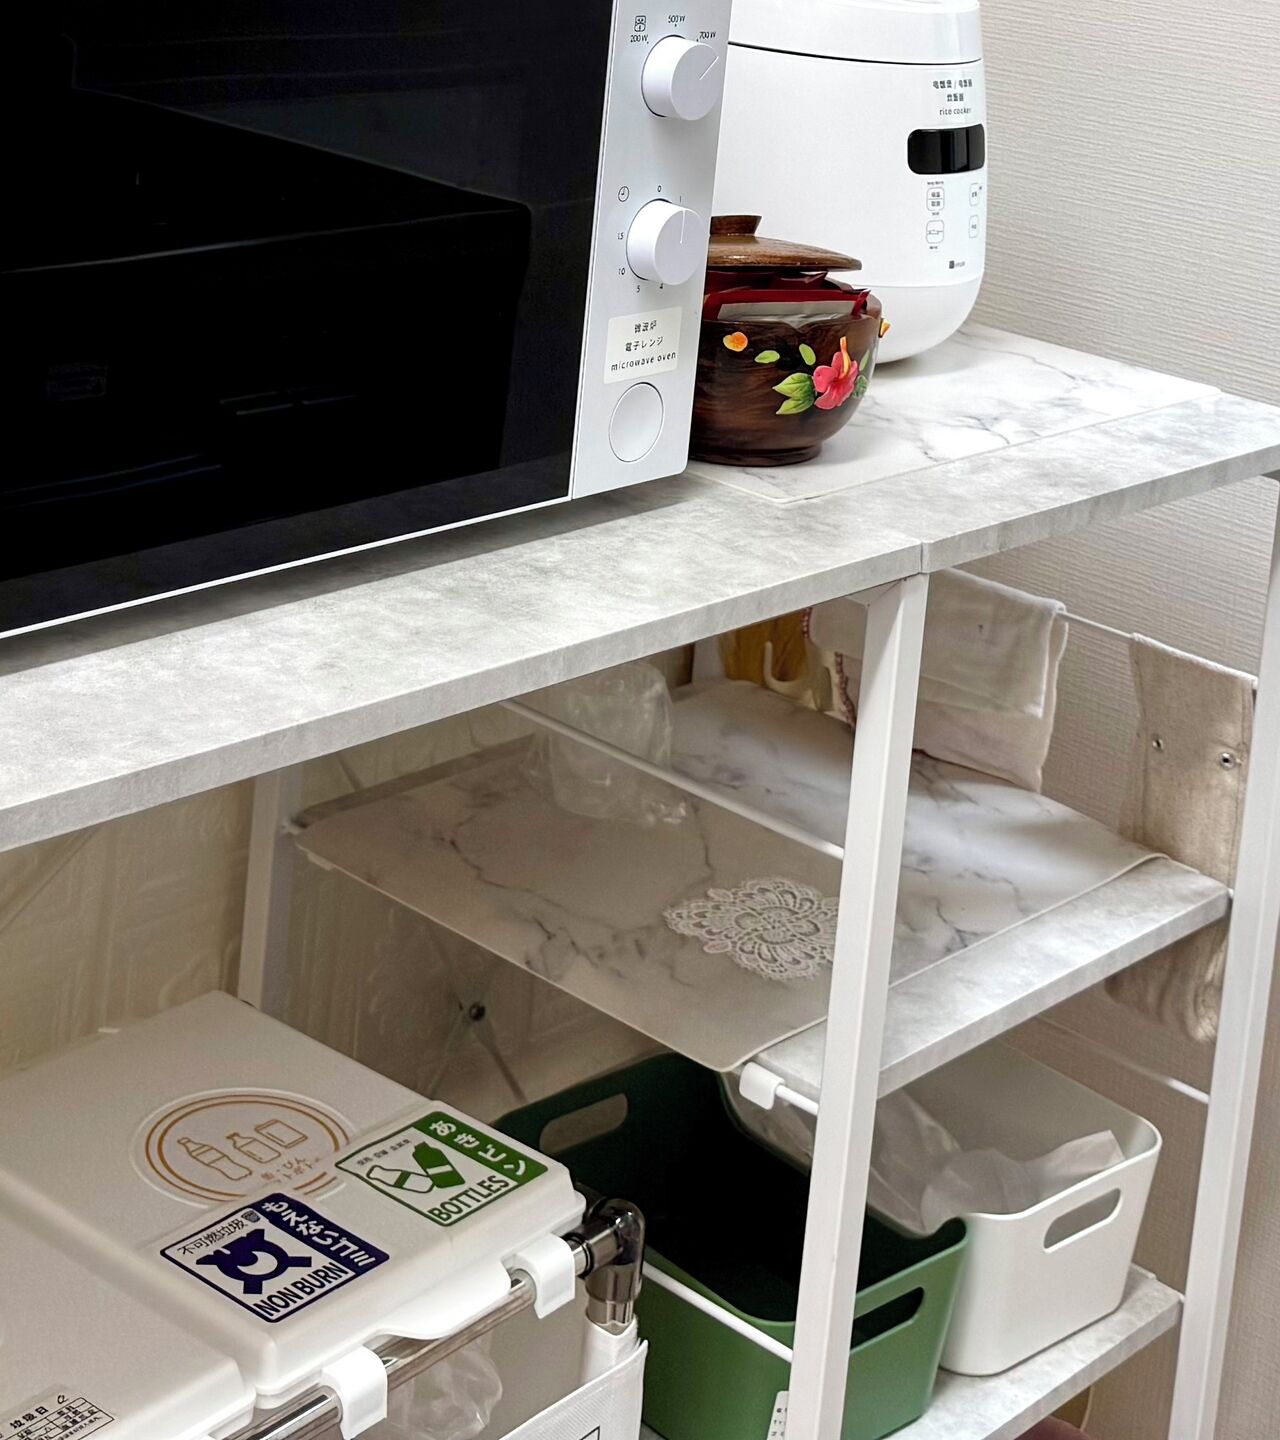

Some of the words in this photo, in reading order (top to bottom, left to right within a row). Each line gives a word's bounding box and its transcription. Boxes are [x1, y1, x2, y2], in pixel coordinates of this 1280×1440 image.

[939, 108, 952, 116] rice
[610, 356, 655, 372] microwave
[657, 351, 676, 362] oven
[625, 335, 664, 352] 電子レンジ
[429, 1120, 526, 1176] あきビン
[428, 1174, 510, 1222] BOTTLES
[177, 1218, 248, 1255] 不可燃垃圾
[261, 1201, 376, 1268] もえないゴミ
[253, 1283, 303, 1317] NON
[291, 1261, 350, 1297] BURN
